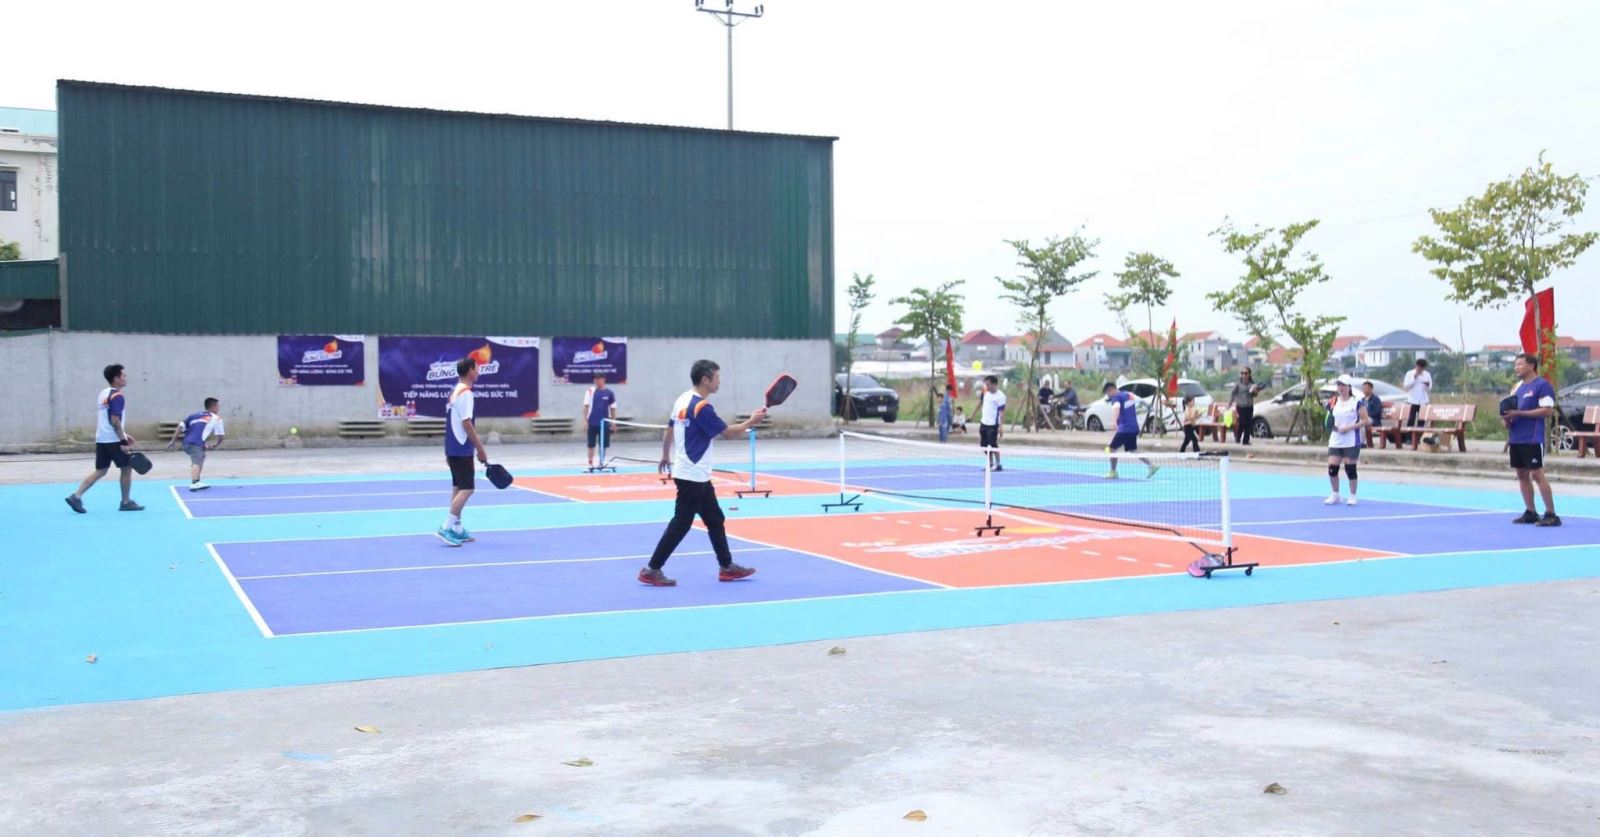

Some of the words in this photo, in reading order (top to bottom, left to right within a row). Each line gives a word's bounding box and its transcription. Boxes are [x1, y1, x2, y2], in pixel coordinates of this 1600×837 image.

[428, 367, 457, 379] BỪNG
[480, 361, 497, 373] TRẺ
[403, 390, 418, 398] TIẾP
[419, 390, 439, 398] NĂNG
[491, 390, 504, 398] SỨC
[505, 389, 518, 398] TRẺ
